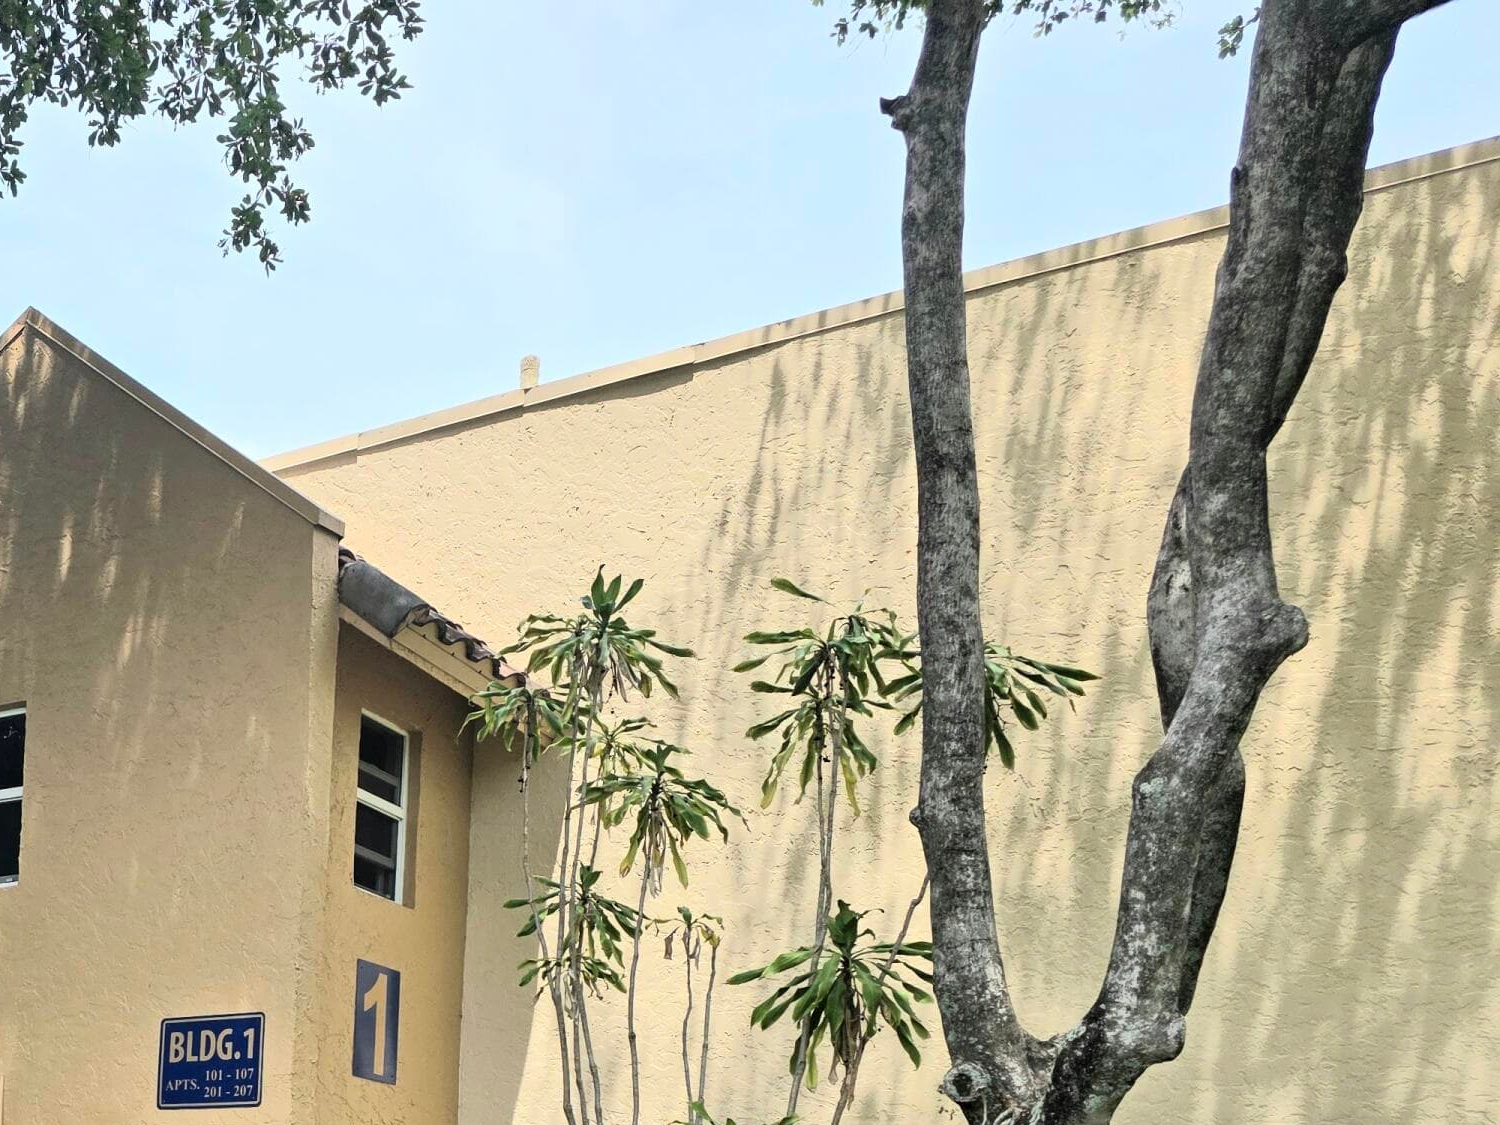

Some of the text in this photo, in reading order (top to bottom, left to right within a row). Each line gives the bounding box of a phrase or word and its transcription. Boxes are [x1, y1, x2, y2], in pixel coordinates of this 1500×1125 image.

[363, 972, 388, 1076] 1
[205, 1069, 223, 1081] 101
[235, 1067, 254, 1080] 107
[165, 1079, 200, 1091] APTS.
[203, 1086, 222, 1098] 201
[233, 1084, 253, 1097] 207
